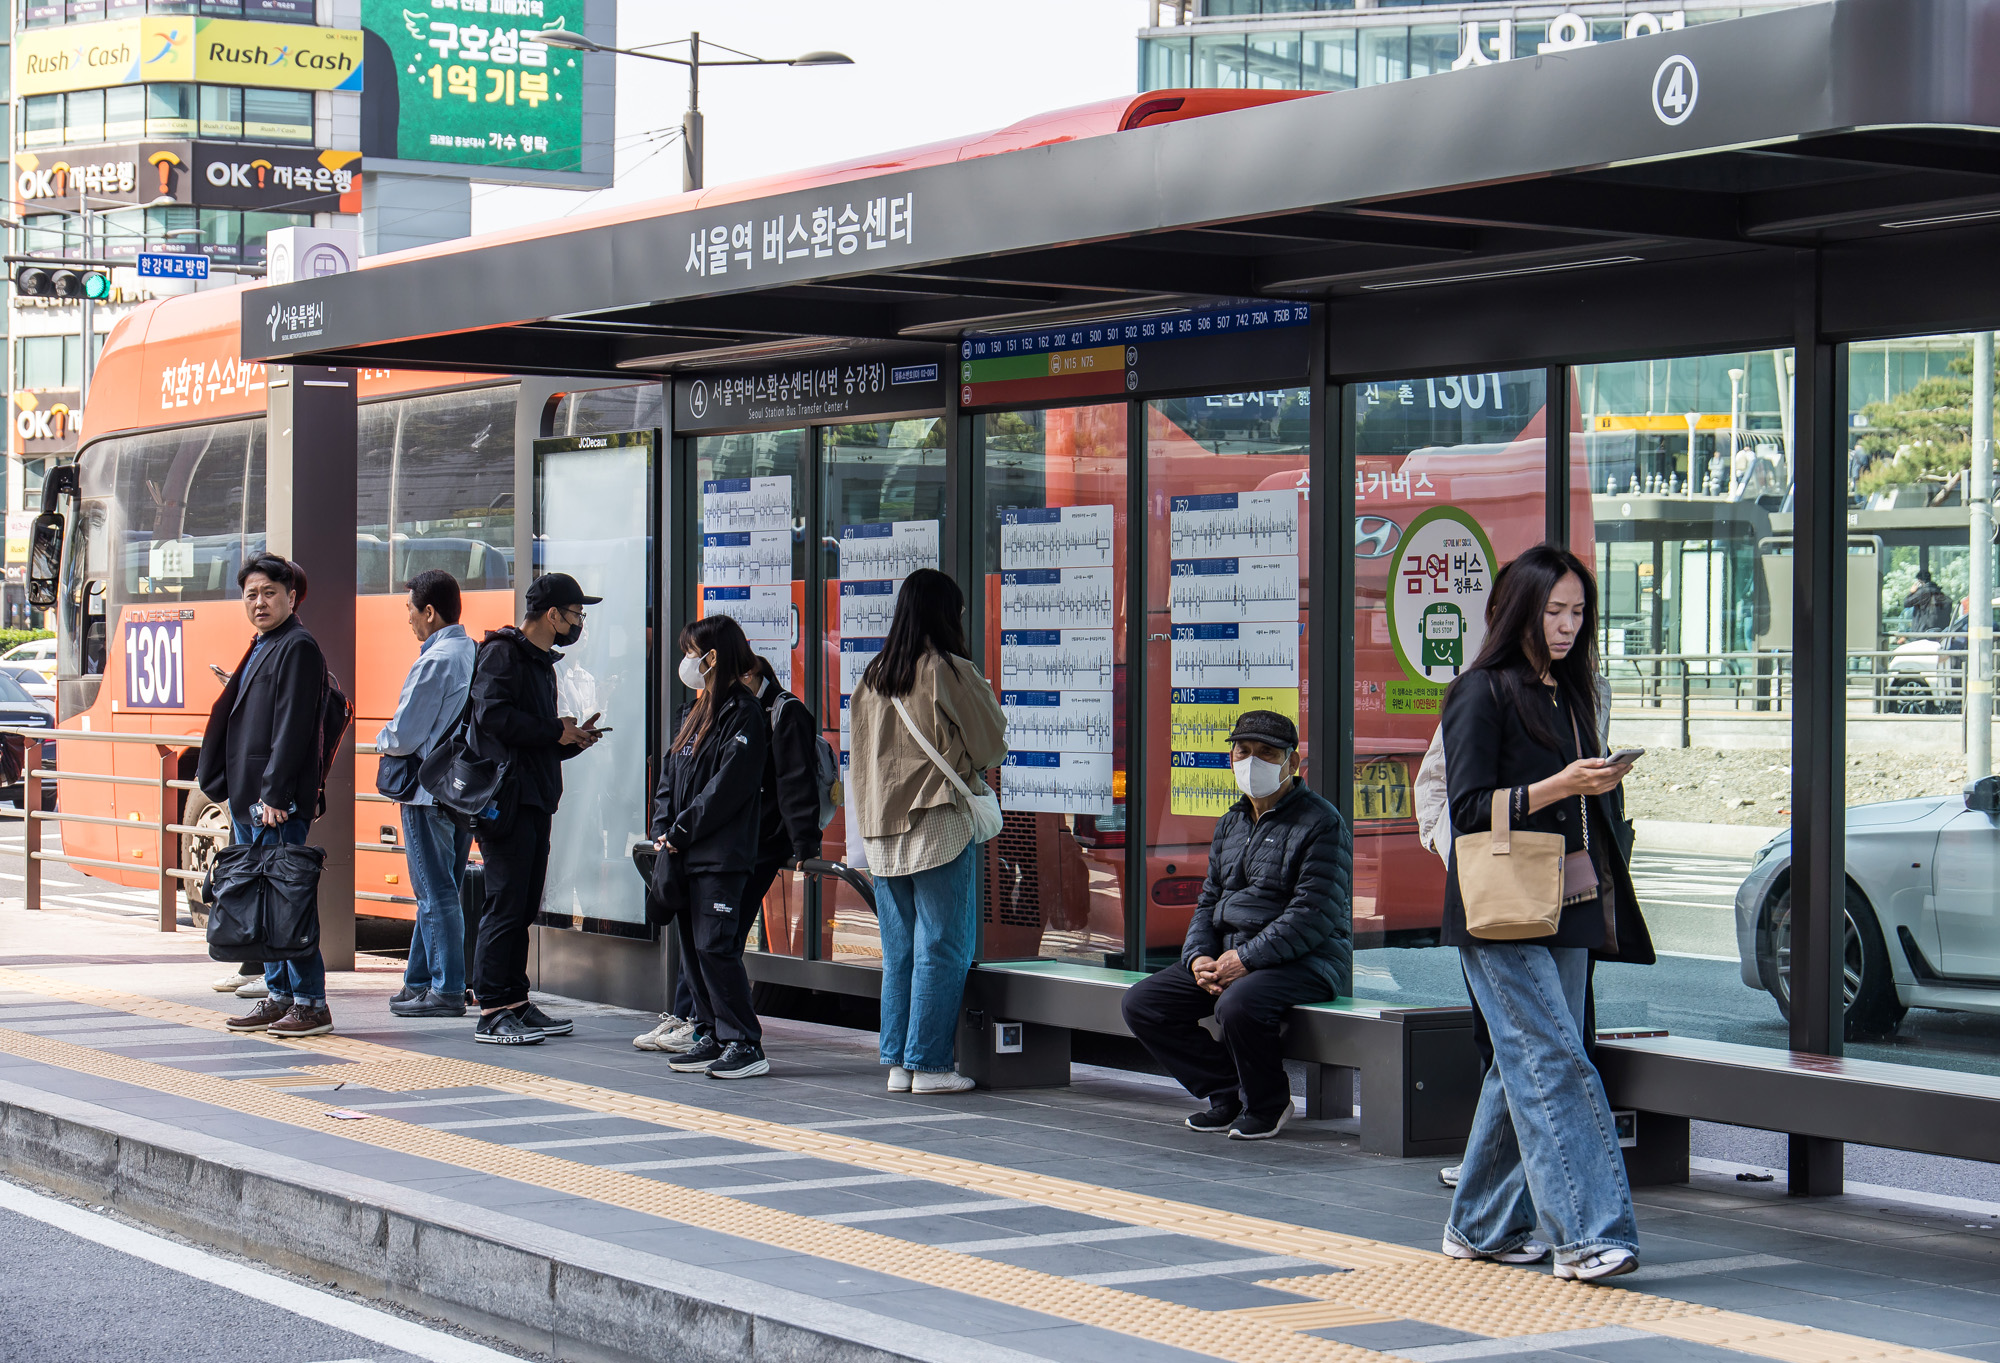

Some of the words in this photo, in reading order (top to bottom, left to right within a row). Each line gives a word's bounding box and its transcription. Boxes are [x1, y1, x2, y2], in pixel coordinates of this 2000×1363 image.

[428, 22, 548, 67] 구호성금
[27, 51, 68, 74] Rush
[88, 43, 130, 67] Cash
[210, 43, 268, 65] Rush
[295, 50, 352, 70] Cash
[428, 64, 477, 102] 1억
[485, 68, 548, 108] 기부
[489, 132, 517, 150] 가수
[273, 166, 352, 194] 저축은행
[684, 220, 752, 277] 서울역
[762, 192, 912, 264] 버스환승센터
[141, 257, 206, 276] 한강대교방면
[281, 301, 324, 330] 서울특별시
[975, 342, 986, 354] 100
[990, 342, 1002, 352] 150
[1006, 340, 1016, 351] 151
[1022, 338, 1032, 350] 152
[1038, 336, 1049, 348] 162
[1054, 334, 1066, 346] 202
[1072, 332, 1082, 344] 421
[1090, 330, 1101, 342] 500
[1108, 328, 1118, 340] 501
[1125, 326, 1138, 338] 502
[1142, 324, 1154, 336] 503
[1161, 322, 1174, 334] 504
[1178, 320, 1192, 332] 505
[1198, 318, 1210, 330] 506
[1217, 316, 1230, 328] 507
[1236, 314, 1248, 326] 742
[1252, 312, 1268, 324] 750A
[1274, 310, 1290, 322] 750B
[1294, 307, 1308, 320] 752
[1064, 357, 1076, 369] N15
[1081, 356, 1094, 368] N75
[161, 357, 205, 410] 친환경
[1426, 372, 1502, 410] 1301
[748, 408, 764, 420] Seoul
[764, 406, 784, 418] Station
[786, 404, 796, 416] Bus
[798, 402, 822, 415] Transfer
[824, 401, 844, 413] Center
[844, 400, 849, 410] 4
[578, 438, 608, 448] JCDecaux
[1176, 500, 1190, 514] 752
[1006, 514, 1018, 526] 504
[1176, 564, 1195, 578] 750A
[1402, 552, 1448, 594] 금연
[1454, 552, 1483, 576] 버스
[1004, 574, 1016, 587] 505
[1454, 577, 1483, 594] 정류소
[1176, 628, 1194, 642] 750B
[1442, 626, 1452, 634] STOP
[1006, 634, 1018, 648] 506
[126, 626, 184, 704] 1301
[1005, 695, 1017, 708] 507
[1180, 688, 1196, 702] N15
[1180, 752, 1195, 766] N75
